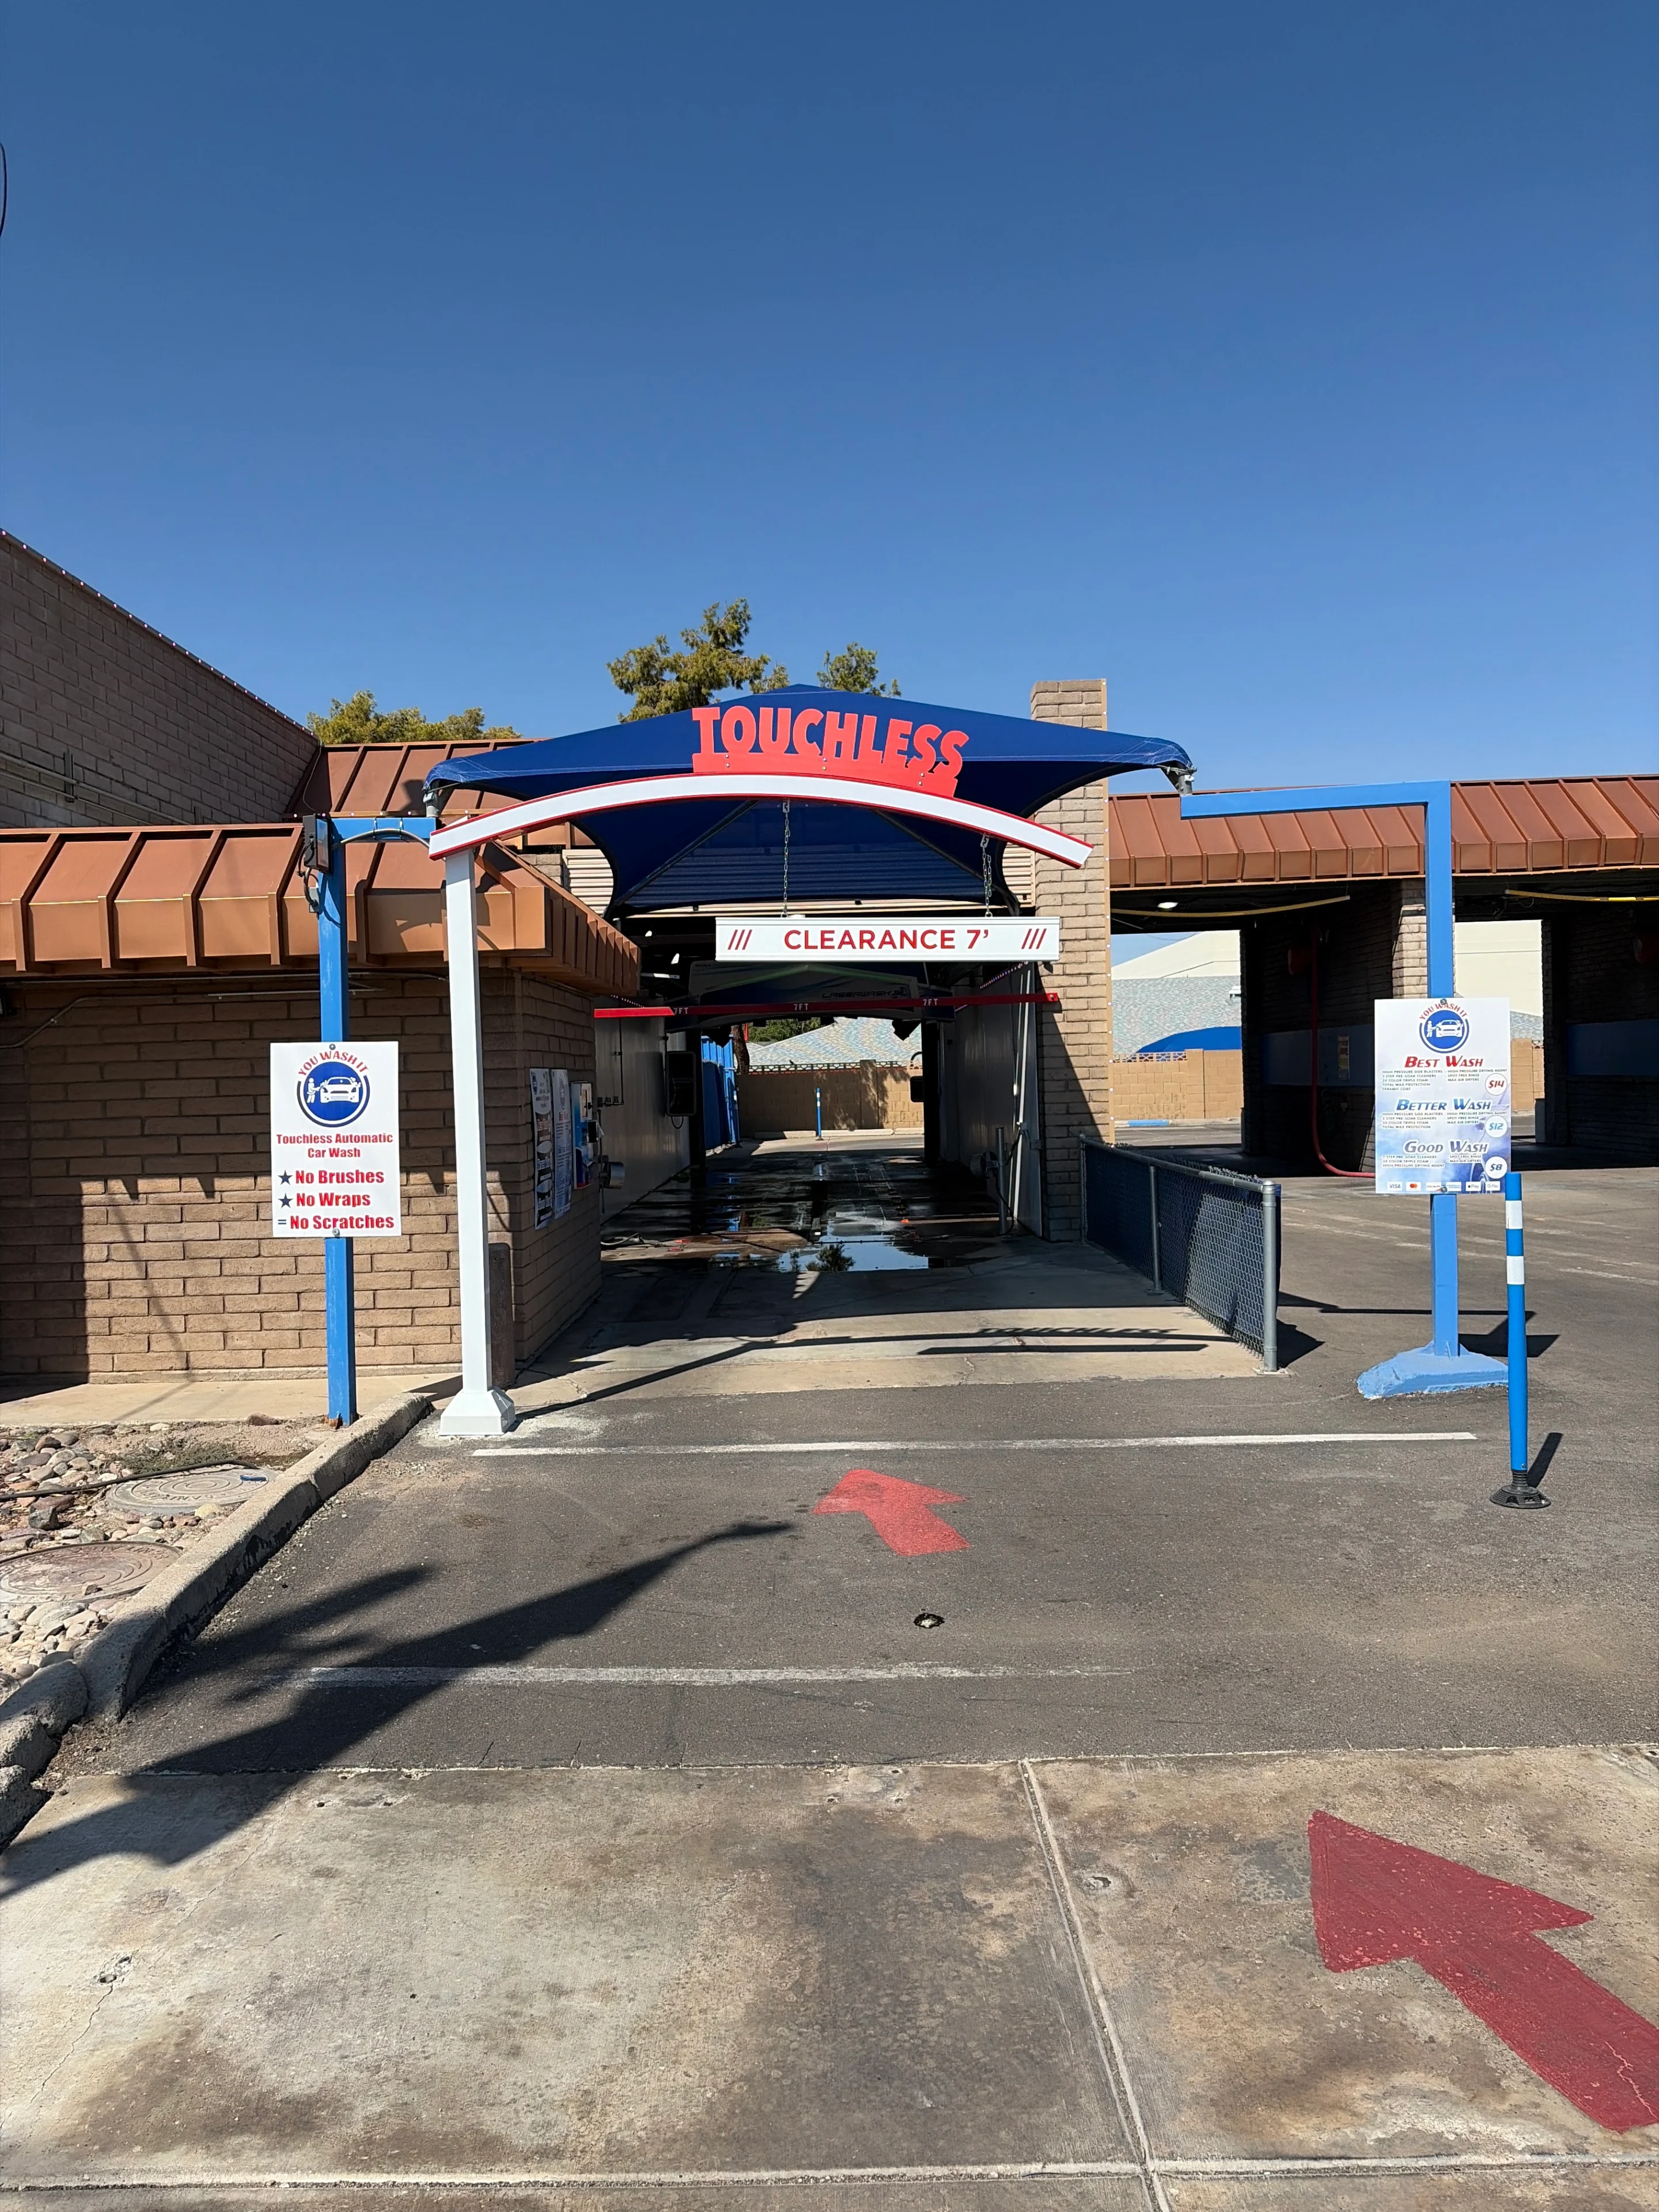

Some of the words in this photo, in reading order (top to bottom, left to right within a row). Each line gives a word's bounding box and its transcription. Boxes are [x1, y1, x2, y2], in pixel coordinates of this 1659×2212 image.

[692, 706, 969, 774] TOUCHLESS
[784, 929, 955, 950] CLEARANCE
[922, 998, 938, 1006] 7FT
[1419, 1006, 1434, 1020] YOU
[1435, 1003, 1461, 1012] WASH
[298, 1056, 319, 1077] YOU
[319, 1051, 359, 1067] WASH
[356, 1062, 369, 1073] IT
[1404, 1056, 1440, 1068] BEST
[1445, 1055, 1483, 1067] WASH
[1488, 1080, 1505, 1089] $14
[1396, 1099, 1447, 1111] BETTER
[1454, 1099, 1491, 1110] WASH
[276, 1134, 332, 1145] Touchless
[335, 1133, 393, 1144] Automatic
[308, 1147, 326, 1158] Car
[329, 1147, 361, 1158] Wash
[1404, 1141, 1443, 1153] GOOD
[1450, 1141, 1488, 1153] WASH
[296, 1171, 314, 1184] No
[319, 1170, 384, 1184] Brushes
[297, 1193, 315, 1207] No
[319, 1193, 371, 1207] Wraps
[290, 1215, 309, 1229] No
[313, 1215, 395, 1229] Scratches
